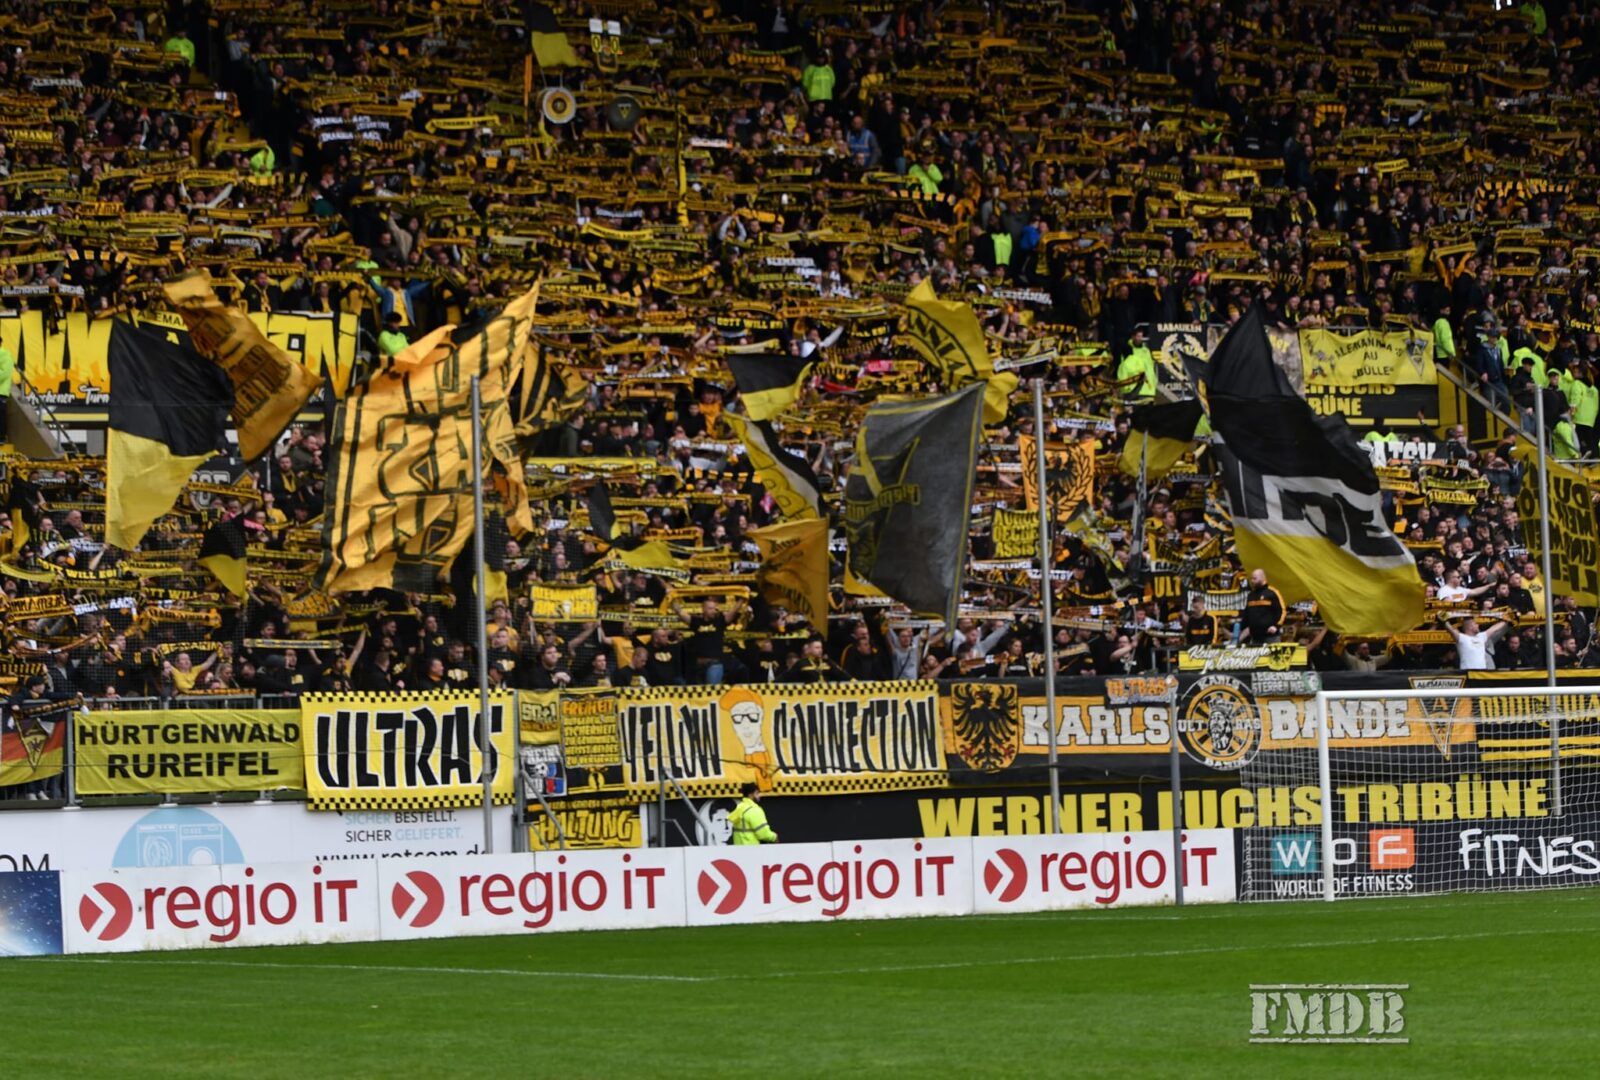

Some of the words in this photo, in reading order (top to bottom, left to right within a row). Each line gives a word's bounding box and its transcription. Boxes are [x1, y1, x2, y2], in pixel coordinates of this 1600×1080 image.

[743, 318, 768, 329] WILL
[66, 568, 97, 580] WILL
[79, 720, 299, 745] HÜRTGENWALD
[621, 702, 722, 784] YELLOW
[773, 696, 939, 773] CONNECTION
[1021, 705, 1171, 746] KARLS
[1267, 699, 1410, 740] BANDE
[107, 750, 279, 779] RUREIFEL
[315, 702, 503, 790] ULTRAS
[345, 812, 391, 826] SICHER
[395, 810, 457, 824] BESTELLT.
[538, 808, 634, 844] HALTUNG
[918, 791, 1144, 838] WERNER
[1157, 785, 1323, 830] FUCHS
[1337, 773, 1548, 824] TRIBÜNE
[345, 830, 392, 843] SICHER
[395, 826, 463, 841] GELIEFERT.
[761, 844, 900, 917] regio
[914, 842, 955, 897] iT
[1040, 835, 1167, 905] regio
[1182, 834, 1218, 887] iT
[1273, 878, 1325, 897] WORLD
[1353, 873, 1415, 893] FITNESS
[144, 867, 298, 943] regio
[313, 865, 358, 923] iT
[460, 855, 607, 928] regio
[623, 853, 665, 909] iT
